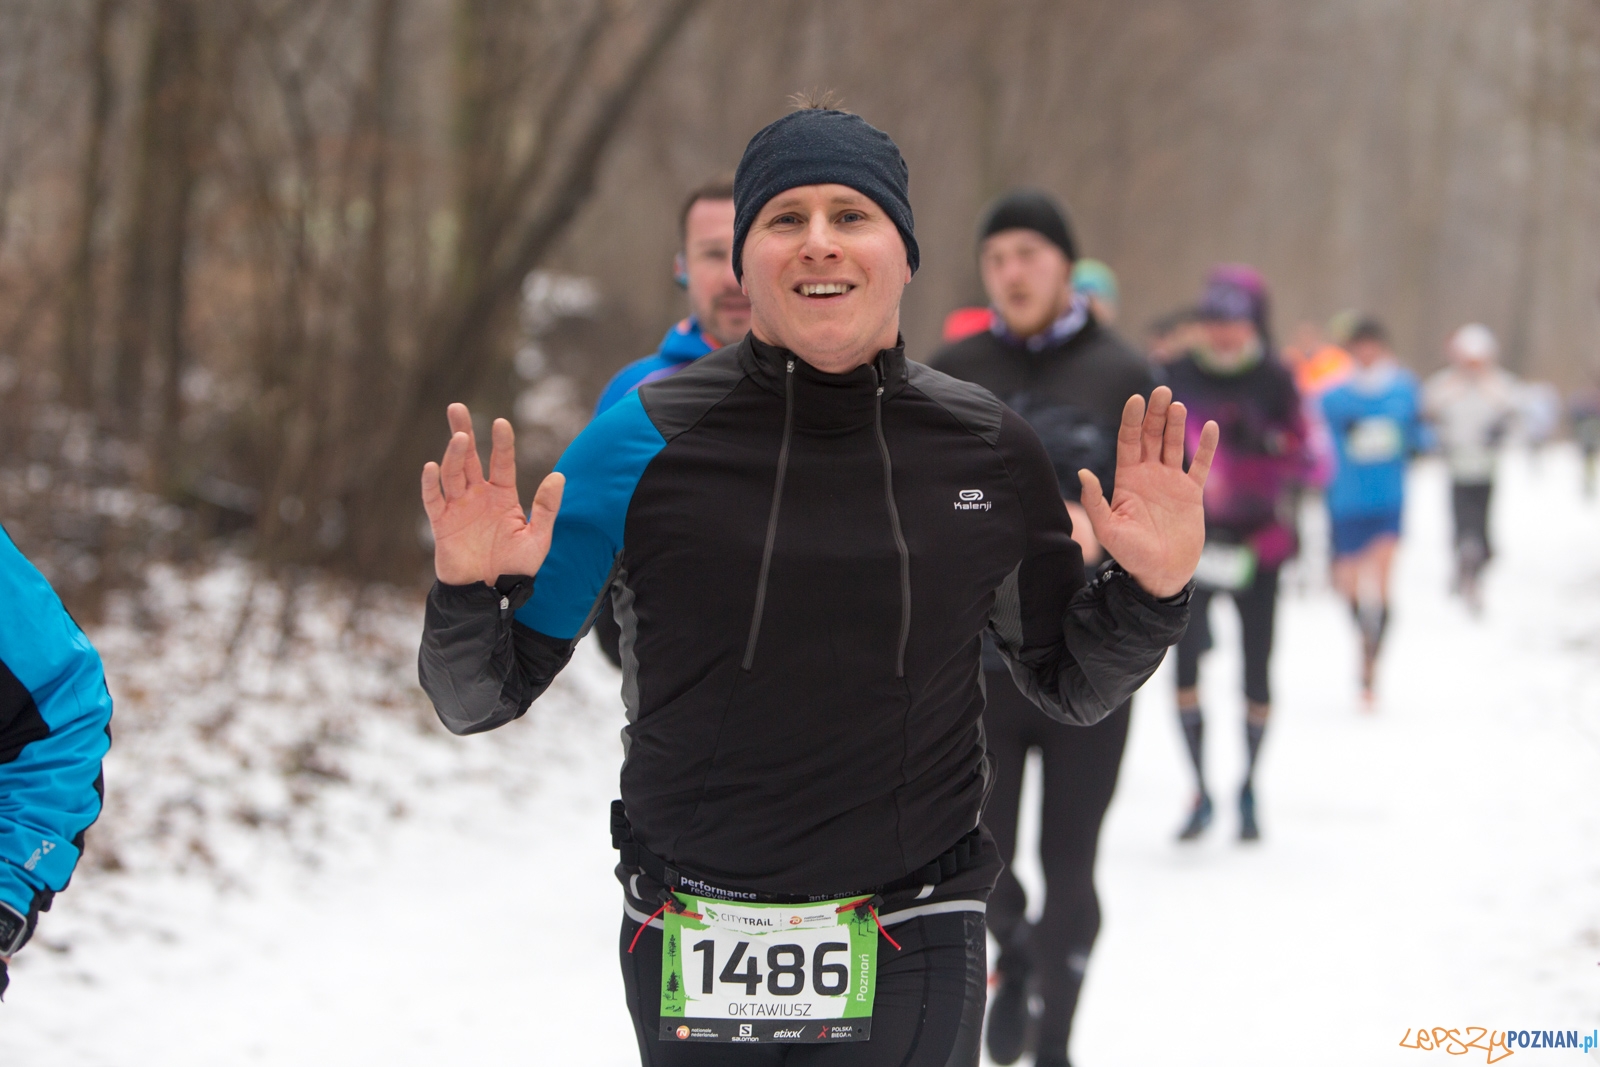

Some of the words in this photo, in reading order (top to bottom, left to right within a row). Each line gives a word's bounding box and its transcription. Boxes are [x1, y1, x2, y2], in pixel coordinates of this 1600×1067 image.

[953, 501, 992, 512] Kalenji
[680, 876, 757, 900] performance
[692, 939, 849, 996] 1486
[856, 953, 870, 1002] Poznań
[728, 1002, 813, 1017] OKTAWIUSZ
